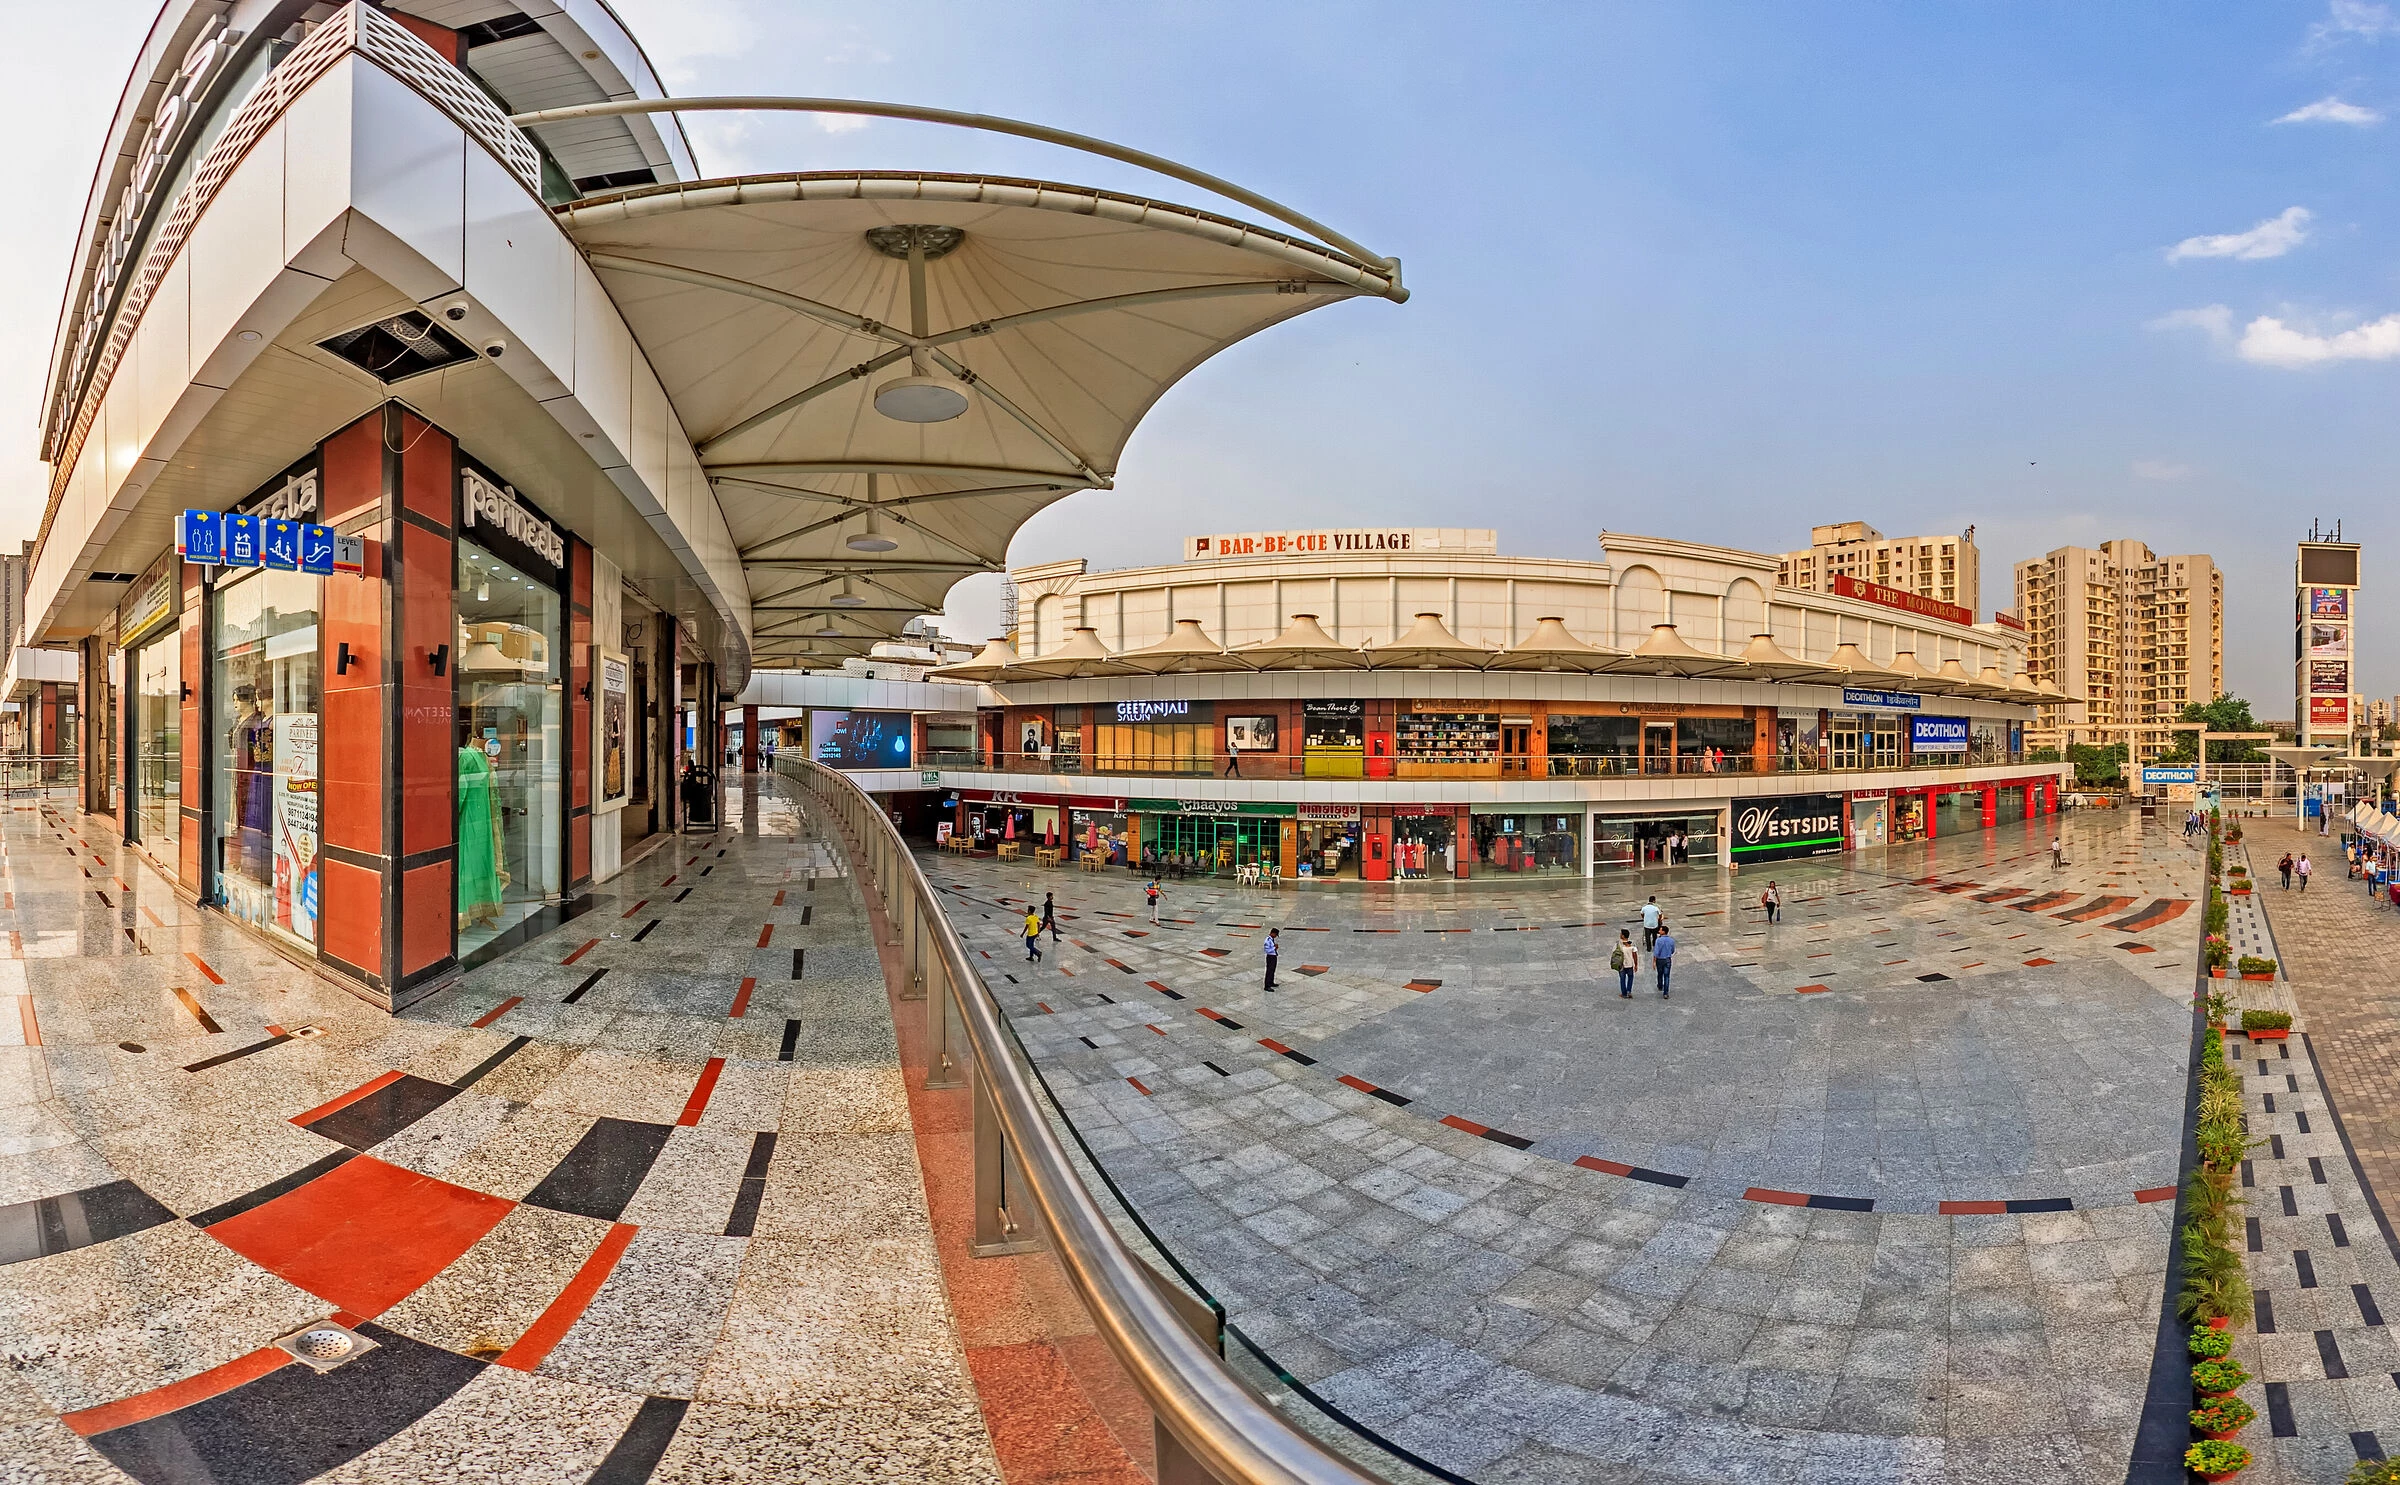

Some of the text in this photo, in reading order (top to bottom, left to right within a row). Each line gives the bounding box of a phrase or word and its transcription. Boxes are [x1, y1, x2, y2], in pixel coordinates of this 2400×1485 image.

[337, 537, 358, 547] LEVEL
[1219, 533, 1411, 555] BAR-BE-CUE VILLAGE
[342, 547, 349, 561] 1
[1874, 587, 1960, 620] THE MONARCH
[1845, 692, 1883, 703] DECATHLON
[1117, 701, 1188, 717] GEETANJALI
[1117, 714, 1151, 722] SALON
[1916, 722, 1965, 738] DECATHLON
[2145, 771, 2193, 780] DECATHLON
[303, 781, 317, 789] OPE
[992, 791, 1022, 803] KFC
[1178, 799, 1238, 814] Chaayos
[1737, 805, 1839, 844] WESTSIDE
